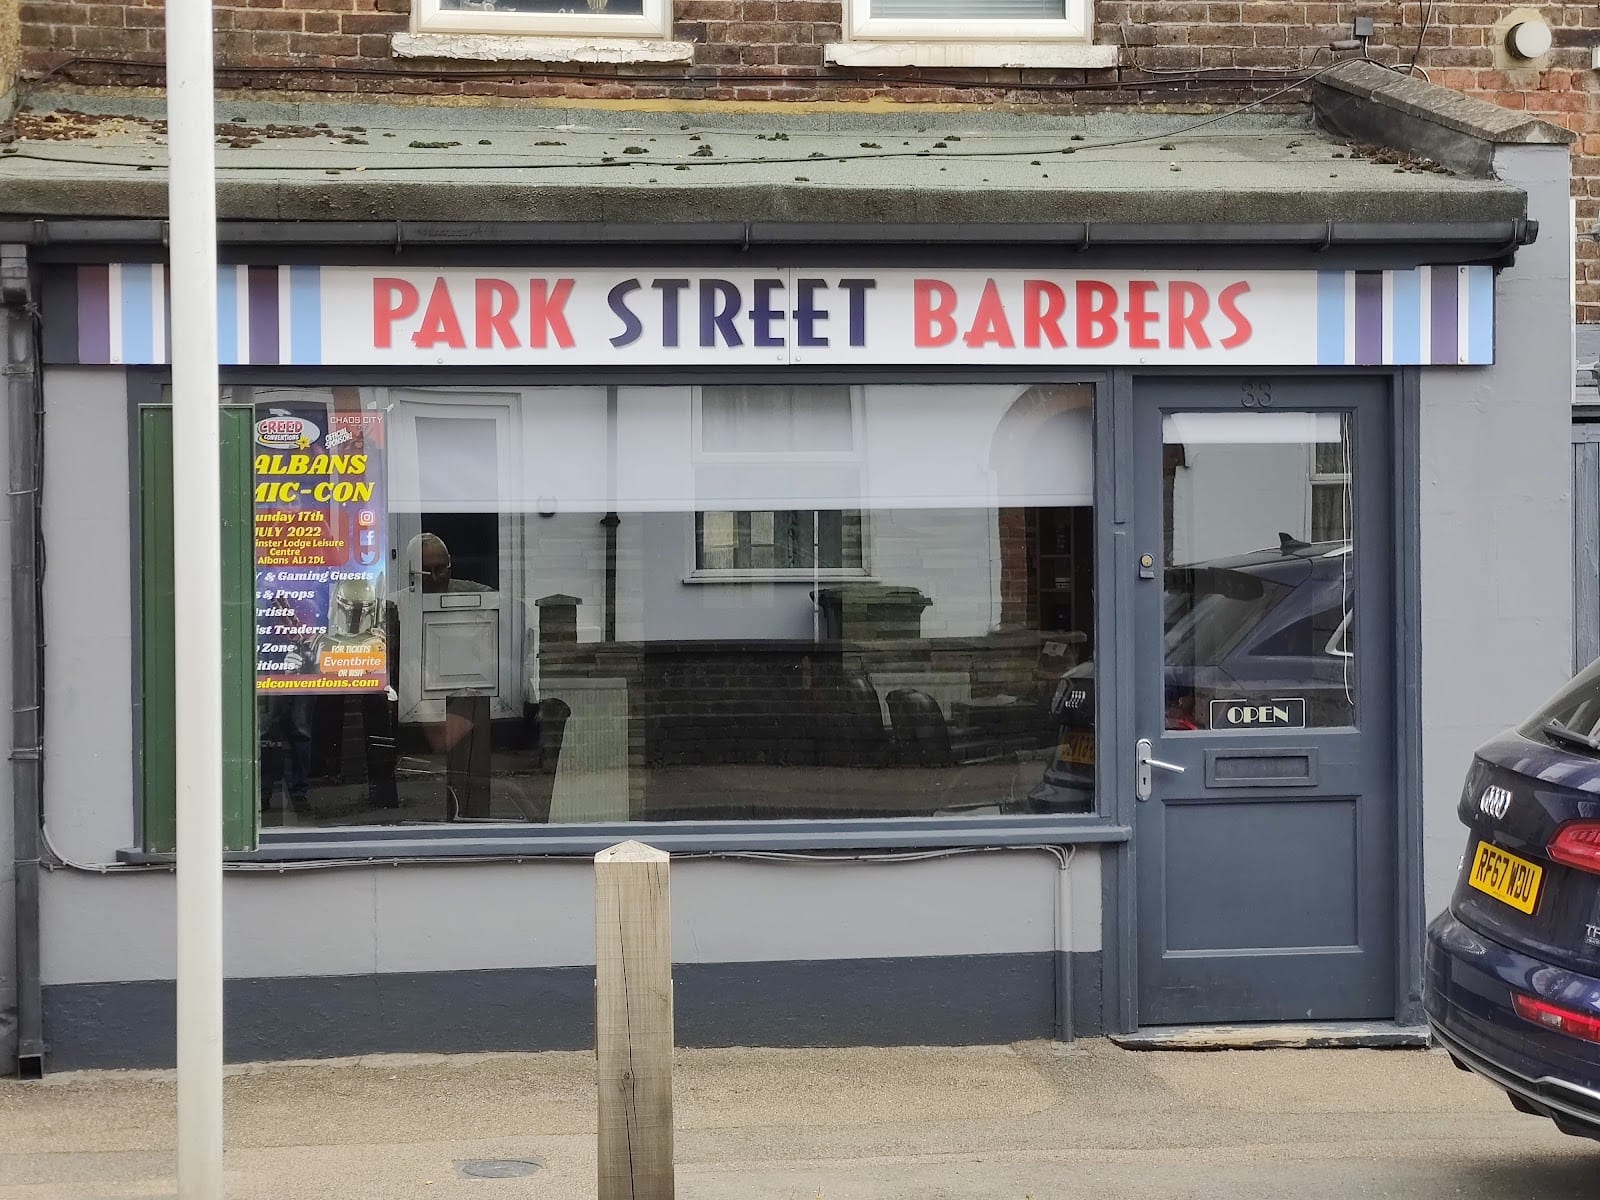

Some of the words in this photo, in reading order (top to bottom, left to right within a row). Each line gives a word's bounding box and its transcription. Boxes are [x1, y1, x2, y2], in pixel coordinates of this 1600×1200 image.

[372, 277, 575, 349] PARK
[607, 278, 876, 350] STREET
[913, 278, 1254, 351] BARBERS
[330, 416, 361, 424] CHAOS
[363, 416, 384, 424] CITY
[258, 420, 304, 435] CREED
[263, 433, 300, 441] CONVENTIONS
[255, 454, 368, 475] ALBANS
[297, 511, 325, 522] 17th
[255, 526, 283, 538] JULY
[287, 526, 322, 538] 2022
[283, 539, 312, 550] Lodge
[313, 539, 344, 548] Leisure
[269, 548, 301, 556] Centre
[257, 556, 289, 565] Albans
[308, 556, 326, 565] 2DL
[264, 571, 277, 582] &
[278, 570, 329, 583] Gaming
[330, 571, 374, 581] Guests
[262, 590, 275, 601] &
[275, 589, 315, 601] Props
[273, 624, 327, 635] Traders
[261, 643, 296, 653] Zone
[331, 645, 346, 654] FOR
[323, 656, 382, 667] Eventbrite
[337, 669, 348, 678] OR
[1227, 706, 1289, 723] OPEN
[1475, 847, 1510, 891] RF67
[1506, 861, 1536, 903] WDU
